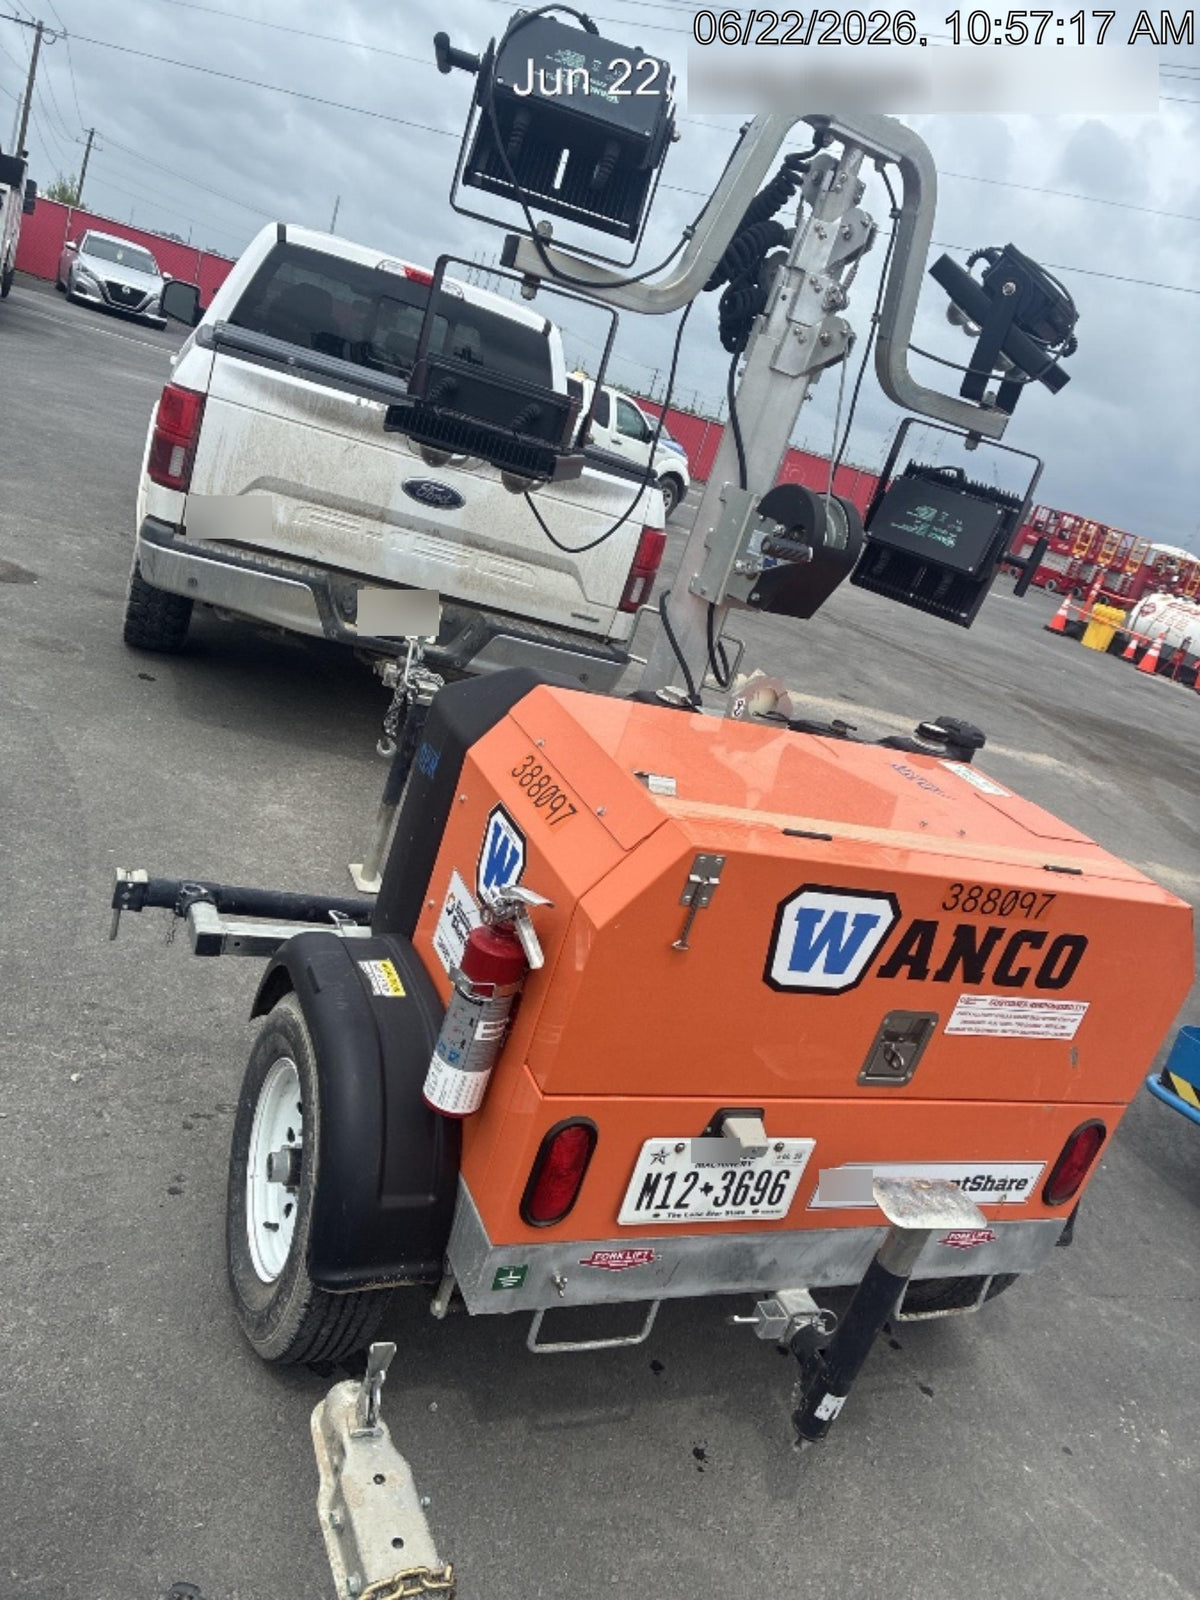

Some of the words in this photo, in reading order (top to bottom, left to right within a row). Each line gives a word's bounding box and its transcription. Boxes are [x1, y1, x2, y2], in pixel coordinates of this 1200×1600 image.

[511, 755, 577, 826] 388097
[483, 819, 521, 890] W
[941, 882, 1057, 920] 388097
[786, 906, 1089, 991] WANCO
